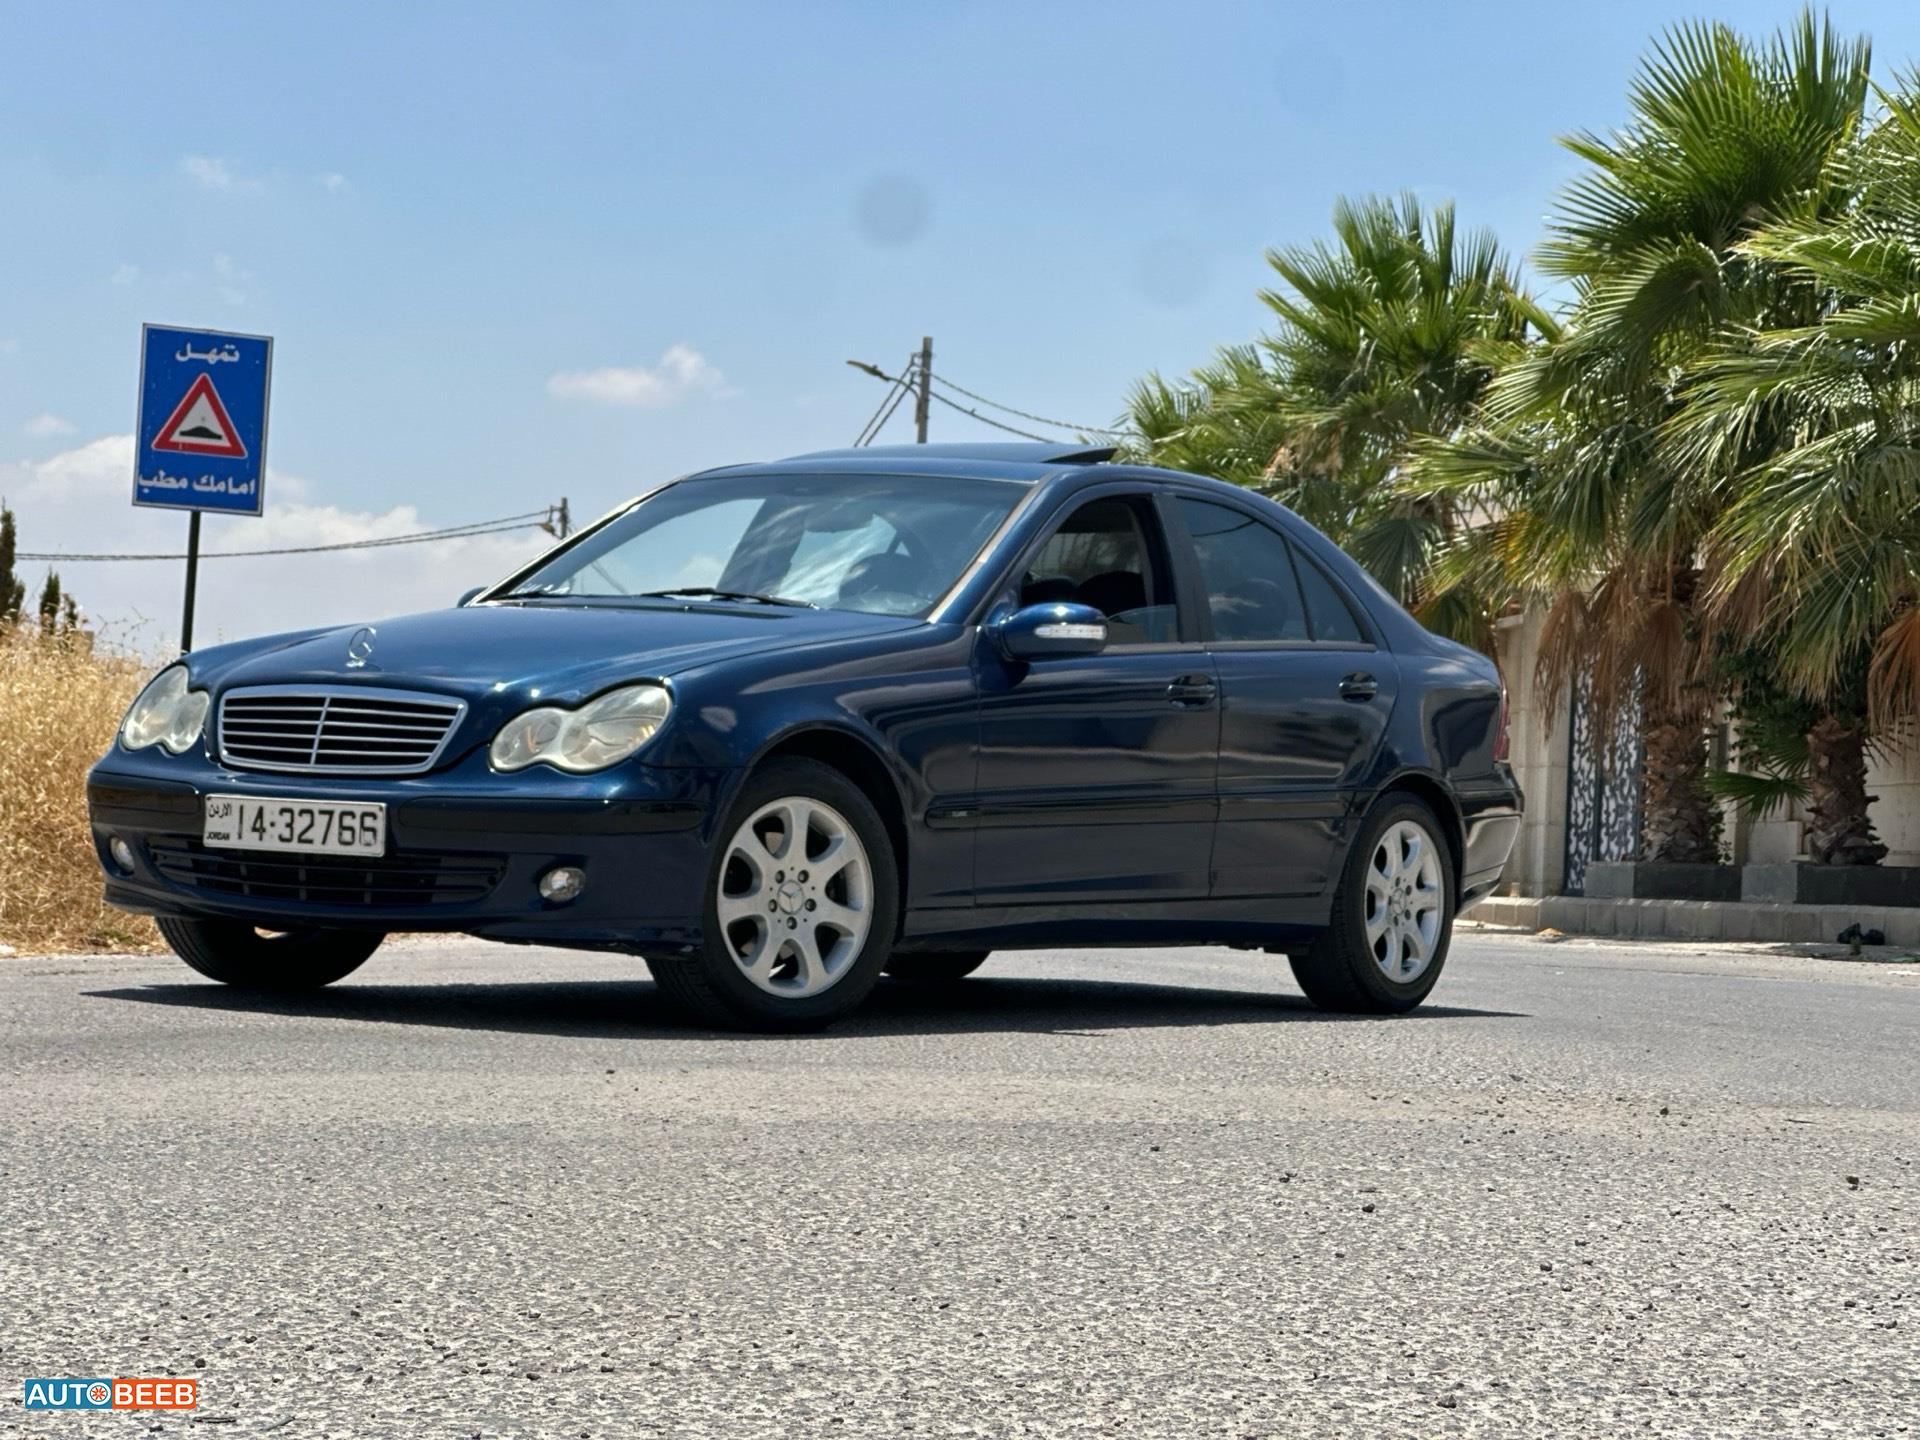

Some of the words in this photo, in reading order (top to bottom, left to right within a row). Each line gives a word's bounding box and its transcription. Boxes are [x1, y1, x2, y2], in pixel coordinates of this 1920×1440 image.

[175, 342, 240, 365] تمهل
[138, 469, 188, 493] مطب
[206, 831, 231, 841] JORDAN
